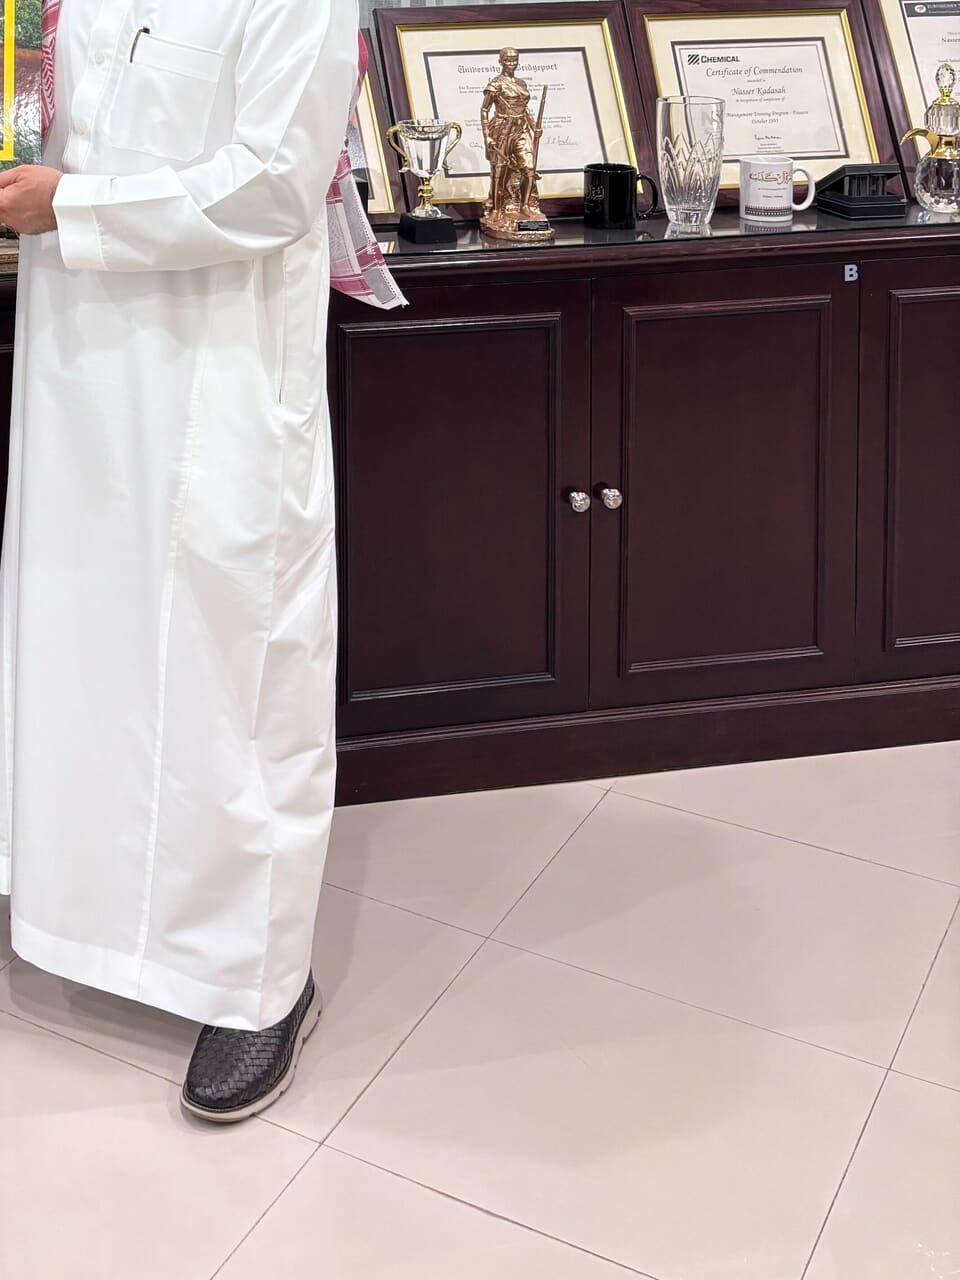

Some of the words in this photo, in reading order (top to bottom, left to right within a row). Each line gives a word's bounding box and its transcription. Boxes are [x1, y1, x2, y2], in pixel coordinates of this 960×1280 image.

[706, 67, 743, 78] Certificate
[744, 67, 753, 77] of
[753, 66, 803, 76] Commendation
[731, 88, 756, 96] Nasser
[844, 264, 858, 281] B
